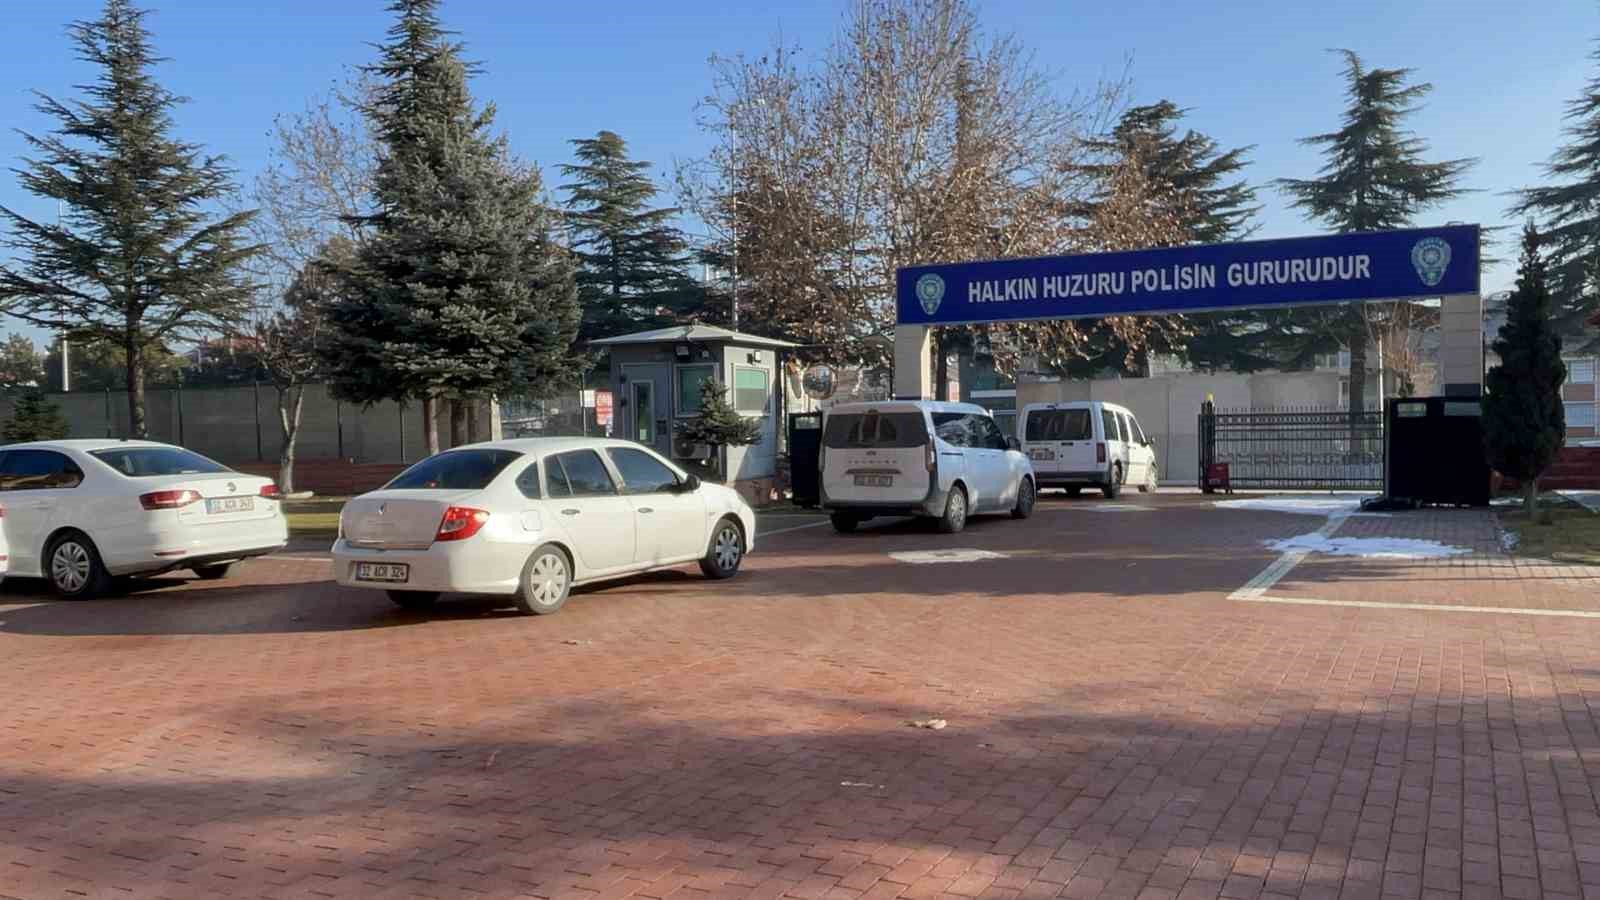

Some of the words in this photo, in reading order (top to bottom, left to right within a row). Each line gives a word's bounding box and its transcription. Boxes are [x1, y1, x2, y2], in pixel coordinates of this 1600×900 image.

[968, 278, 1037, 303] HALKIN
[1043, 271, 1125, 299] HUZURU
[1131, 262, 1216, 294] POLİSİN
[1227, 254, 1371, 288] GURURUDUR
